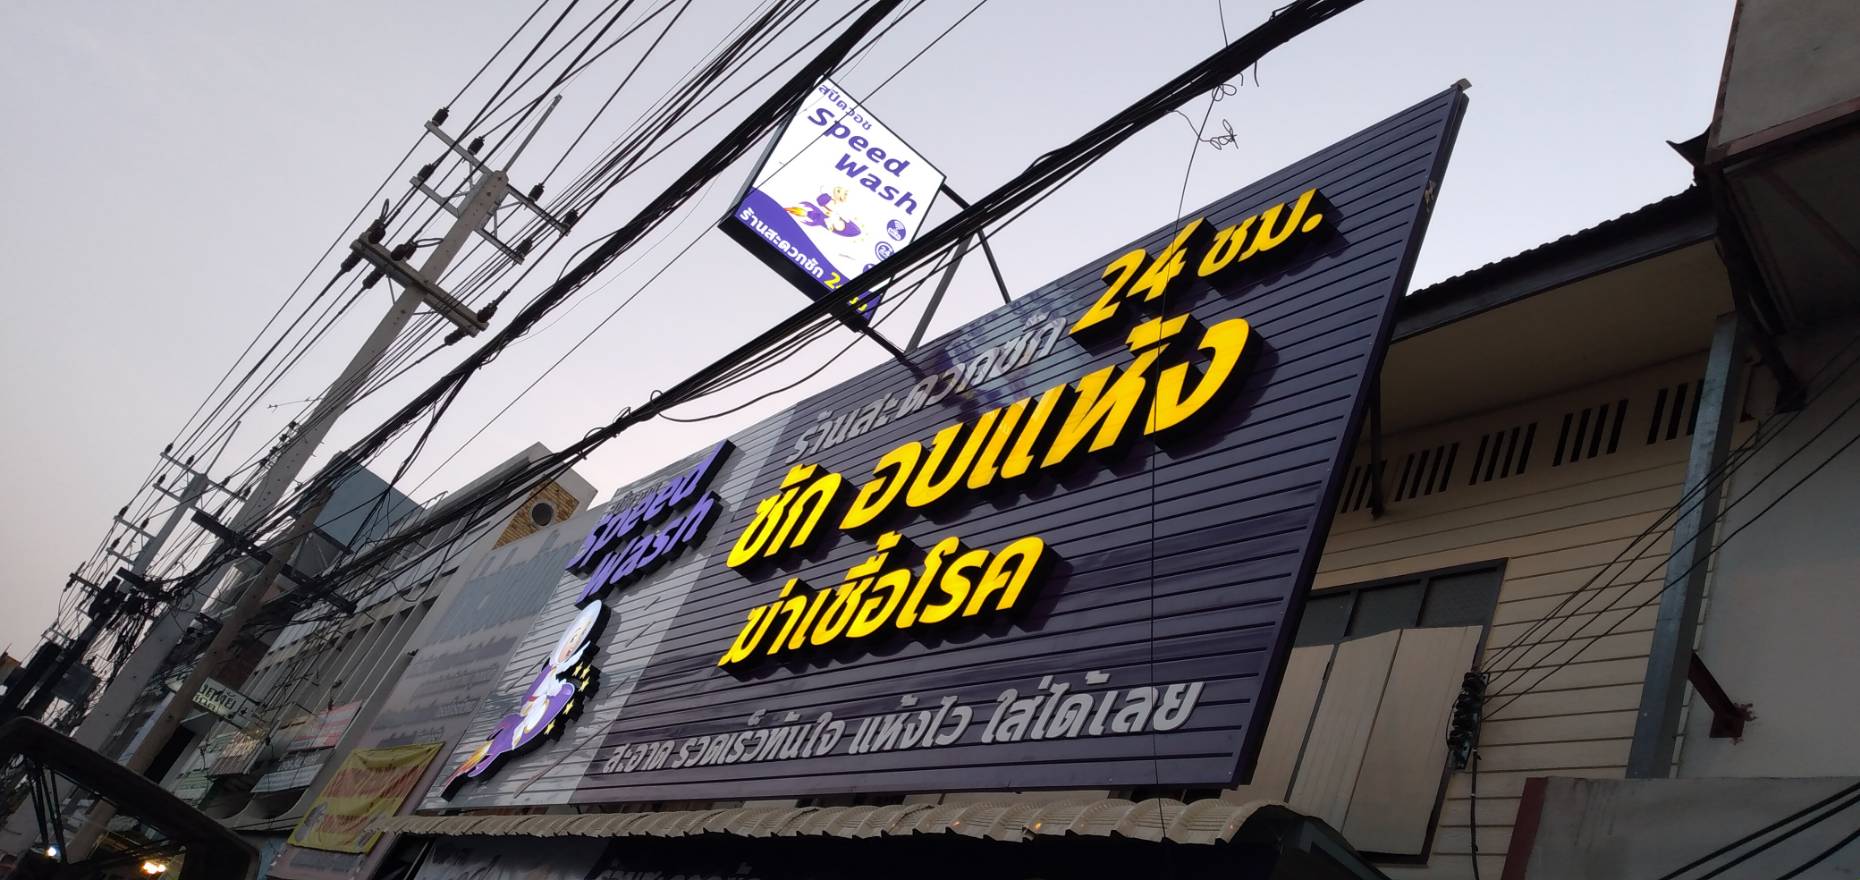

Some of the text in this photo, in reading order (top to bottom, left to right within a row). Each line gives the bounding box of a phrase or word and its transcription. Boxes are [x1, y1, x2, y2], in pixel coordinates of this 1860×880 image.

[808, 107, 910, 178] Speed
[818, 84, 873, 131] สปีดวอช
[834, 153, 918, 216] Wash
[739, 207, 824, 280] ร้านสะดวกซัก
[1068, 187, 1324, 335] 24 ชม.
[726, 312, 1250, 568] ซัก อบแห้ง
[785, 311, 1068, 465] ร้านสะดวกซัก
[717, 529, 1045, 667] ฆ่าเชื้อโรค
[602, 669, 1206, 774] สะอาด รวดเร็วทันใจ แห้งไว ใส่ได้เลย
